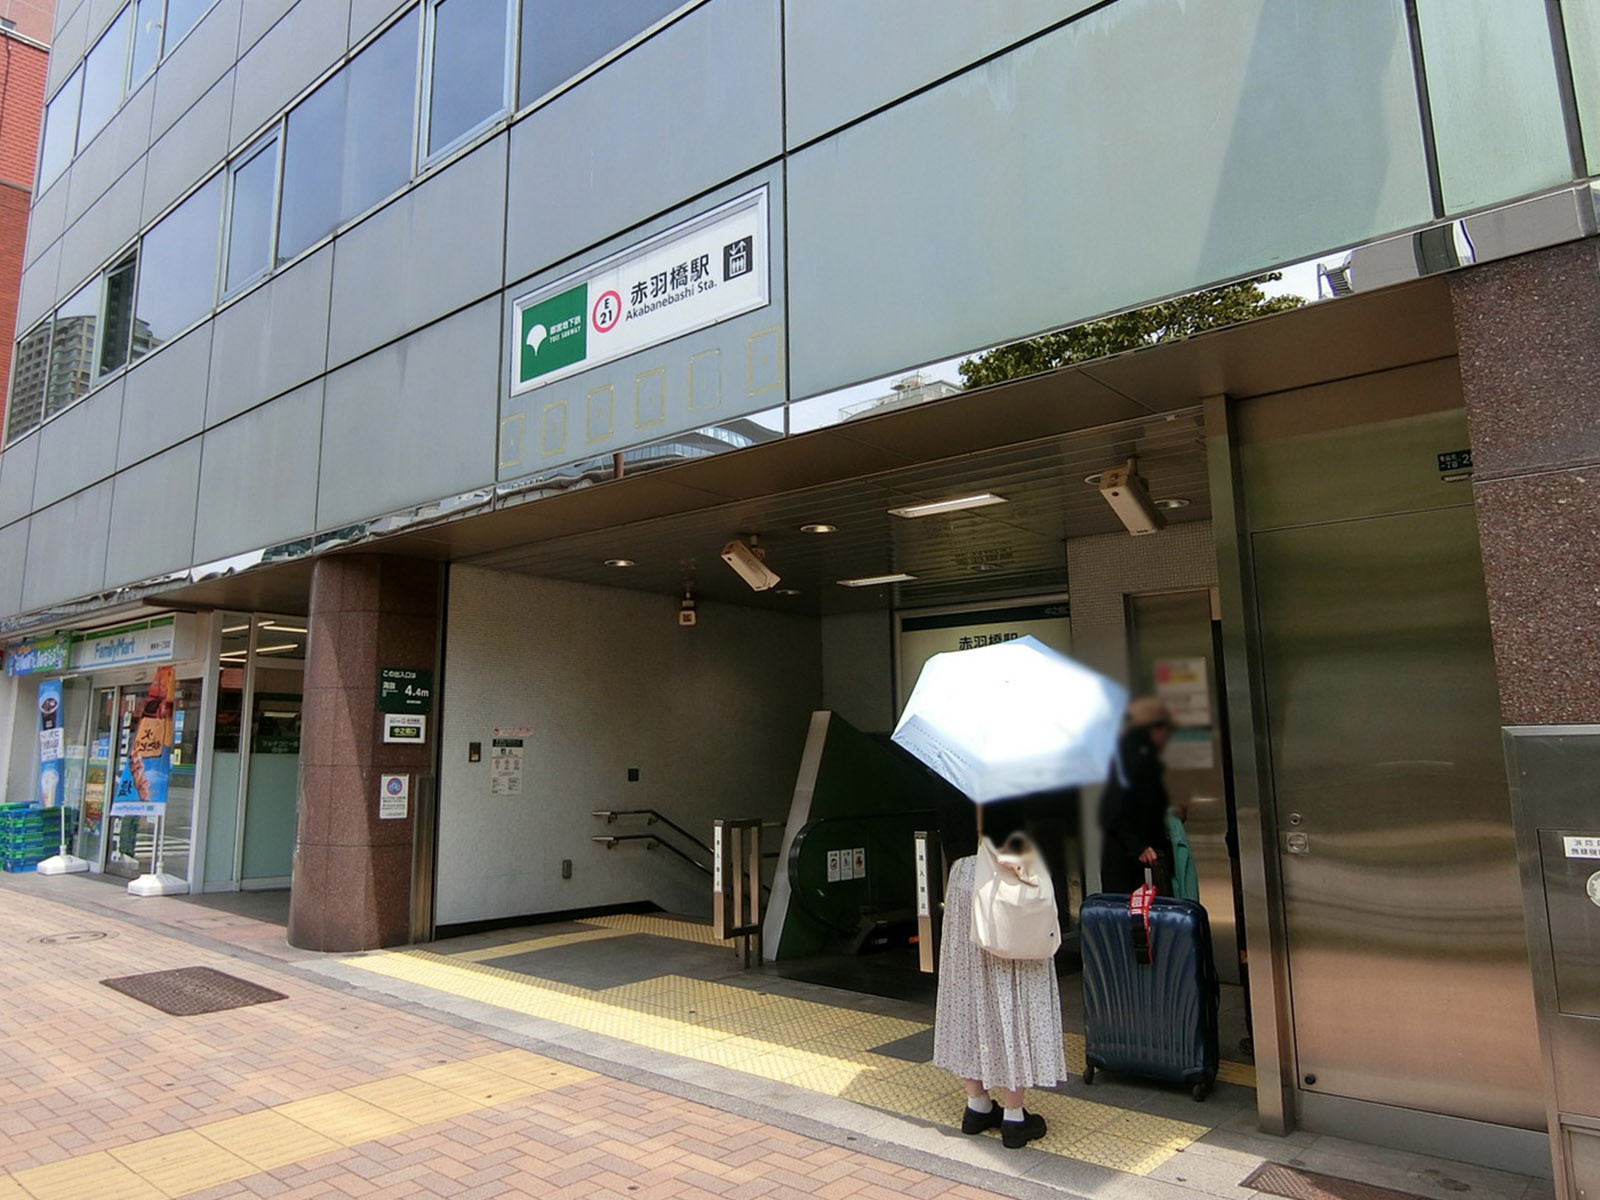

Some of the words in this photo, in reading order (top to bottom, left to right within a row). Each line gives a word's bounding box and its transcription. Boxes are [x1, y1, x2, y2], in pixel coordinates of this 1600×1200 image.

[630, 254, 710, 307] 赤羽橋駅
[603, 298, 611, 309] E
[625, 285, 695, 321] Akabanebashi
[697, 279, 718, 294] Sta.
[550, 315, 582, 336] 都営地下鉄
[600, 310, 613, 325] 21
[94, 636, 136, 660] FamilyMart
[404, 684, 430, 697] 4.4m
